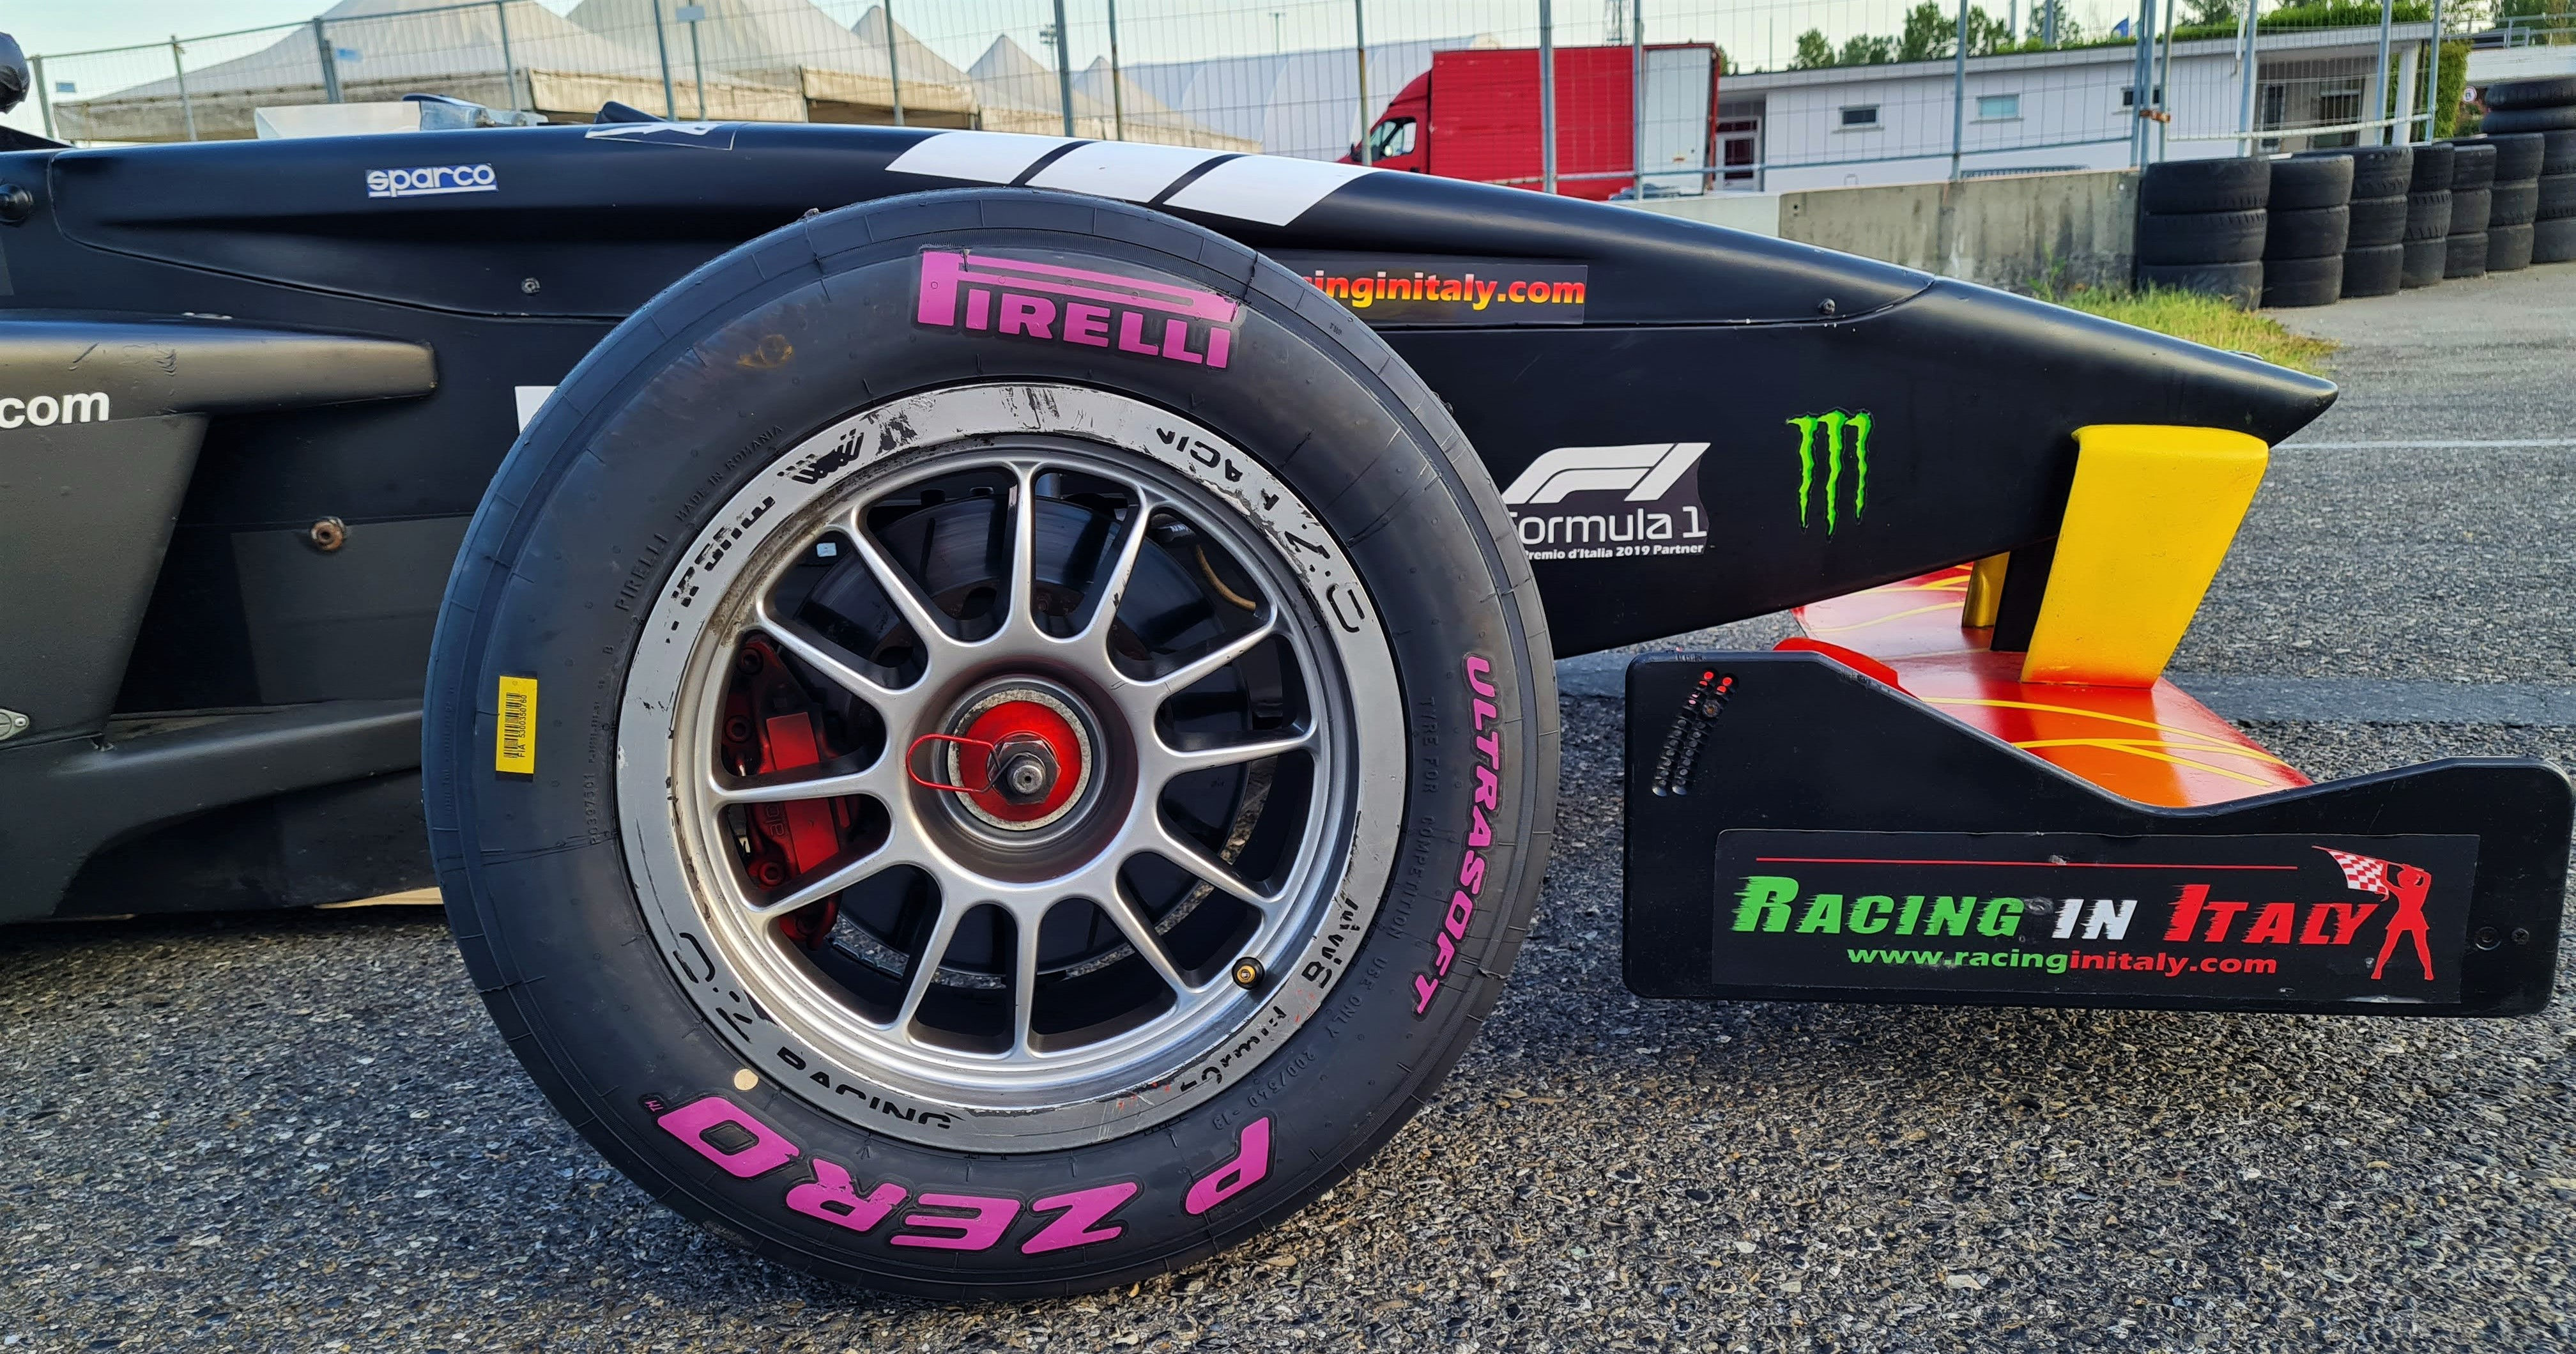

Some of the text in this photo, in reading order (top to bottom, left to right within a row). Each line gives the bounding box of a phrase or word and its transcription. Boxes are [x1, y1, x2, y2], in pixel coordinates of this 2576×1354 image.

[367, 164, 496, 197] sparco
[918, 250, 1238, 369] PIRELLI
[1301, 270, 1586, 311] inginitaly.com
[0, 392, 109, 429] com
[613, 424, 783, 612] PIRELLI MADE IN ROMANIA
[1510, 506, 1708, 545] ormula 1
[1568, 548, 1613, 560] d'Italia
[1616, 545, 1650, 558] 2019
[1653, 544, 1705, 556] Partner
[518, 694, 528, 758] FIA 5300350760
[1420, 696, 1438, 747] TYRE
[1422, 757, 1439, 793] FOR
[1415, 656, 1500, 1014] ULTRASOFT
[1389, 815, 1436, 939] COMPETITION
[1733, 876, 2375, 946] RACING IN ITALY
[1360, 957, 1388, 990] USE
[1846, 948, 2278, 978] www.racinginitaly.com
[1326, 994, 1363, 1038] ONLY
[1248, 1049, 1319, 1107] 200/540
[657, 1096, 1138, 1254] ZERO
[1185, 1117, 1269, 1215] P
